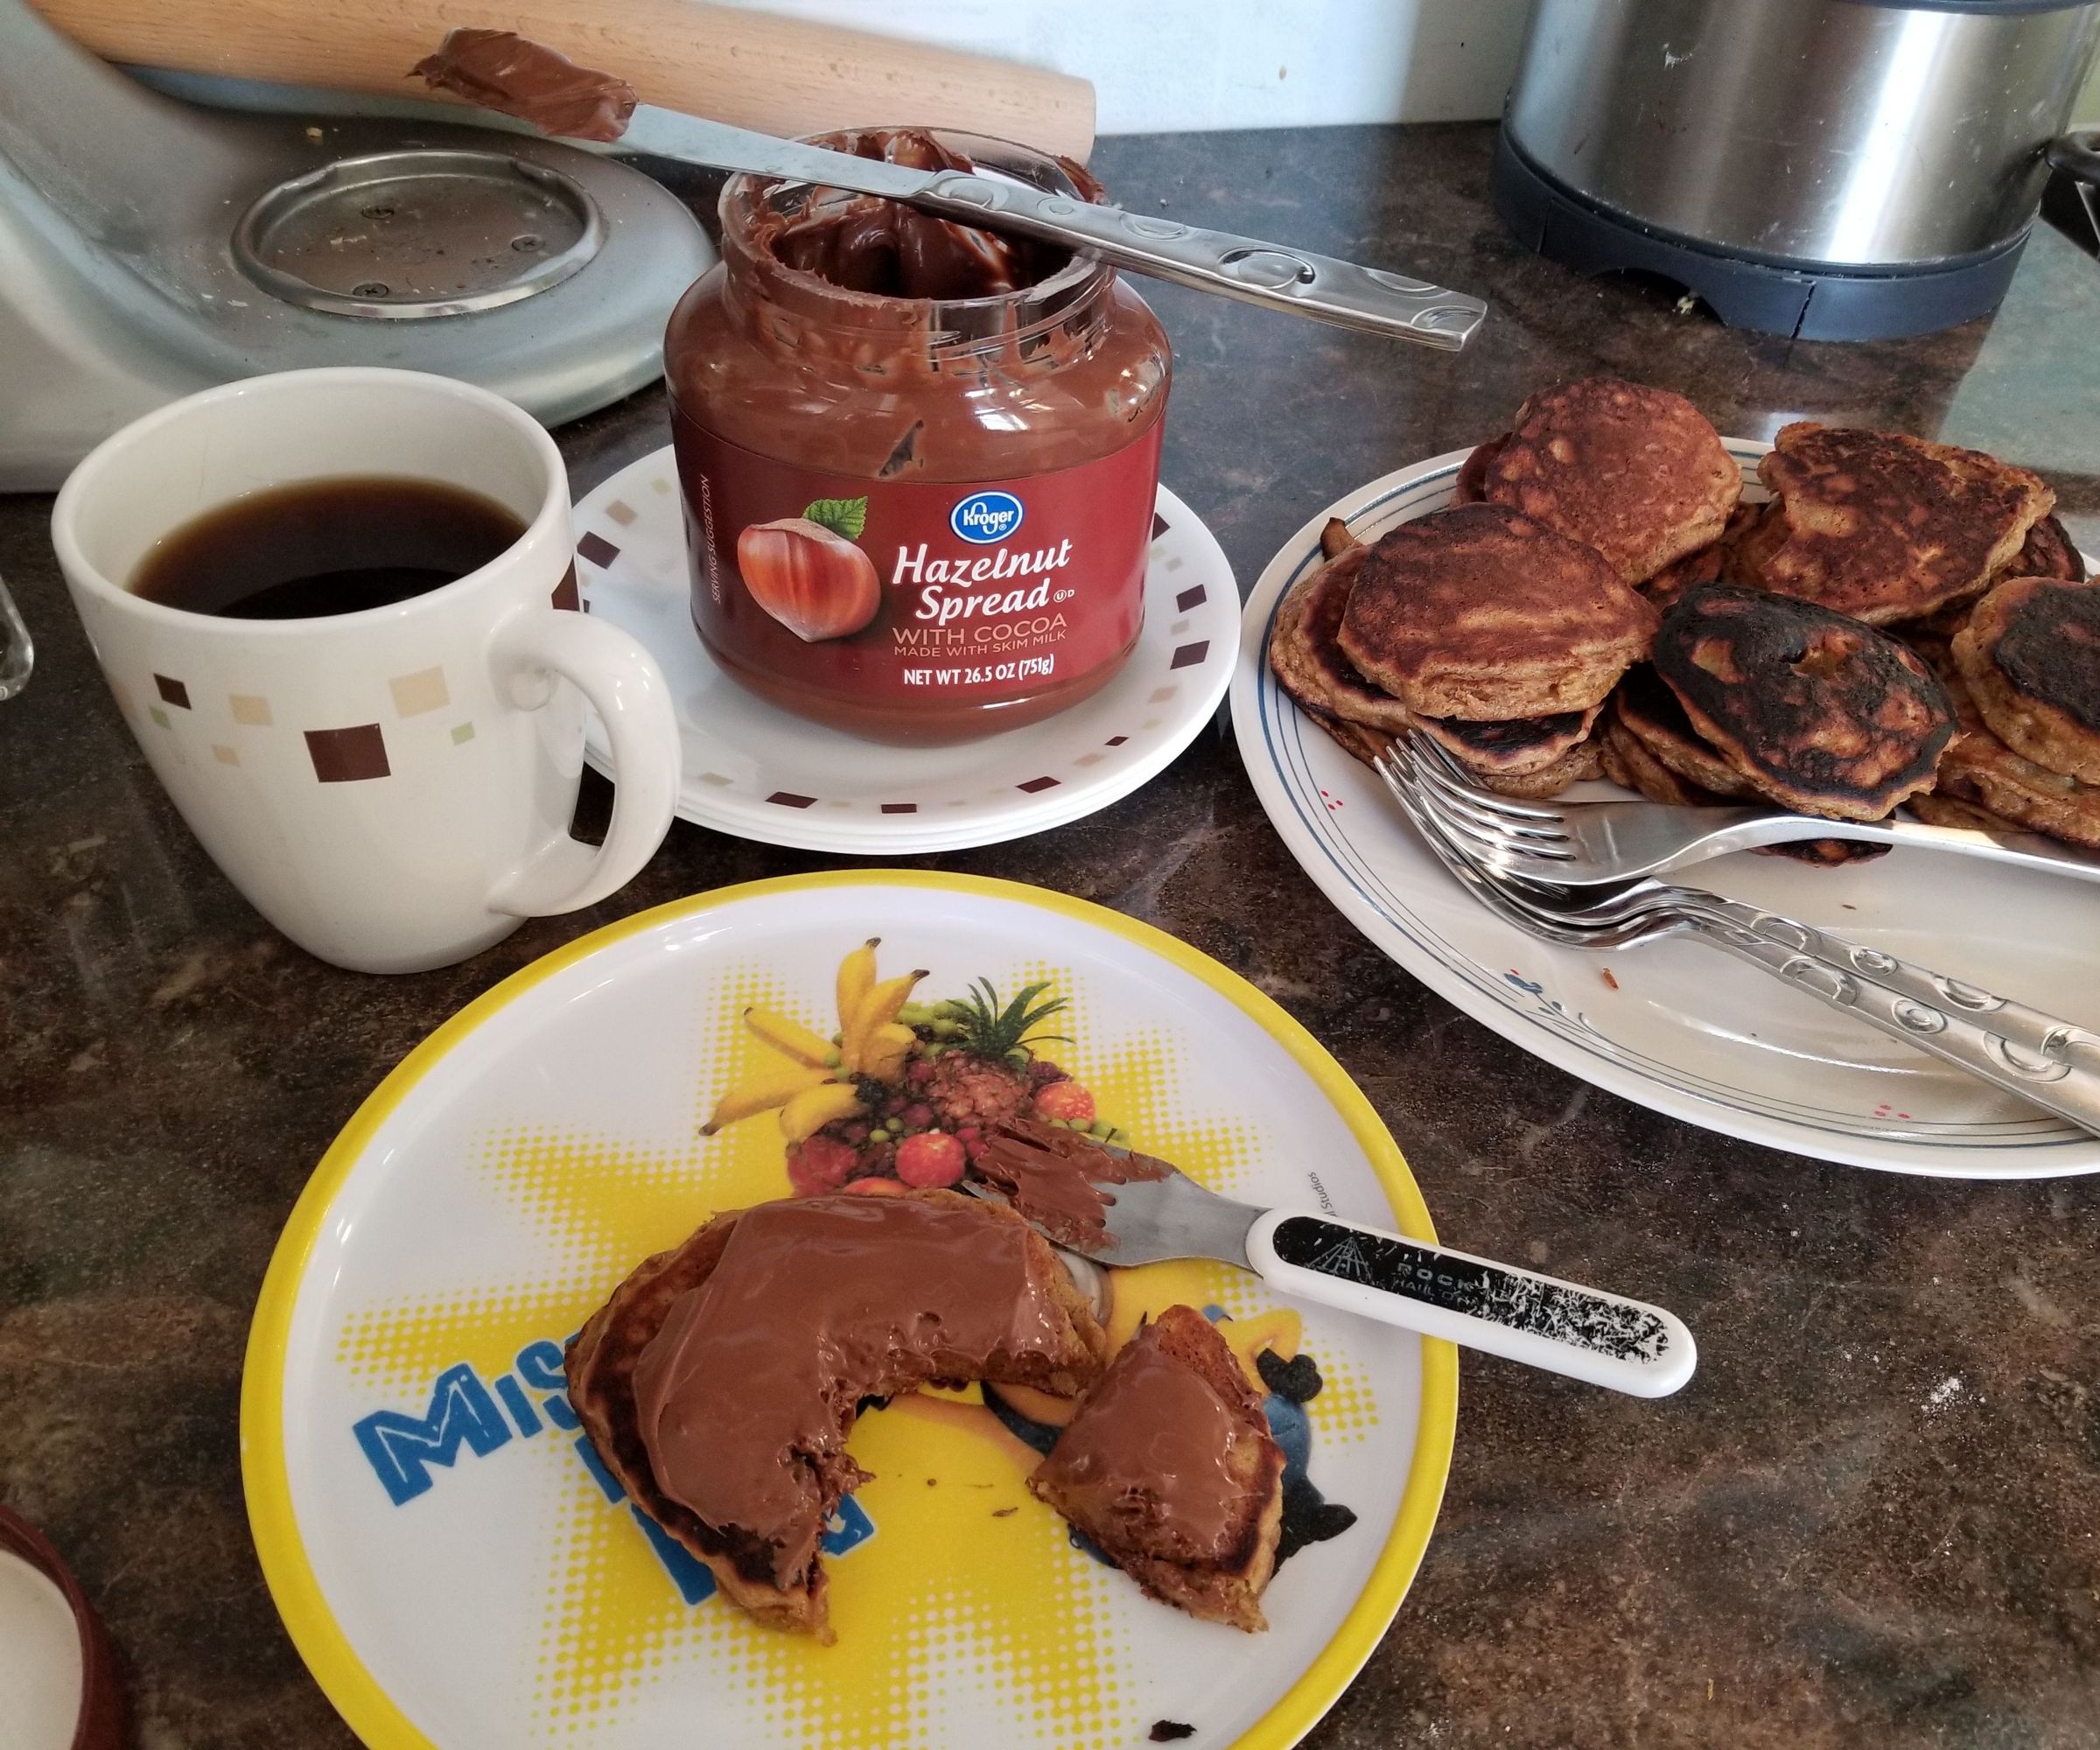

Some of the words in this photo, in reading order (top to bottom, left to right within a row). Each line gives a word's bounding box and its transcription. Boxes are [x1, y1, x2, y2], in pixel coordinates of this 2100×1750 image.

[700, 473, 716, 555] SUGGESTION
[963, 501, 1015, 536] Kroger
[709, 555, 721, 606] SERVING
[892, 538, 1074, 588] Hazelnut
[915, 578, 1051, 626] Spread
[892, 627, 965, 646] WITH
[974, 612, 1068, 643] COCOA
[894, 646, 942, 657] MADE
[947, 645, 988, 656] WITH
[992, 639, 1028, 654] SKIM
[1032, 629, 1067, 648] MILK
[904, 668, 933, 685] NET
[936, 669, 962, 685] WT
[964, 666, 992, 684] 26.5
[995, 662, 1016, 681] OZ
[1018, 654, 1054, 681] (751g)
[1307, 1171, 1334, 1209] Studios
